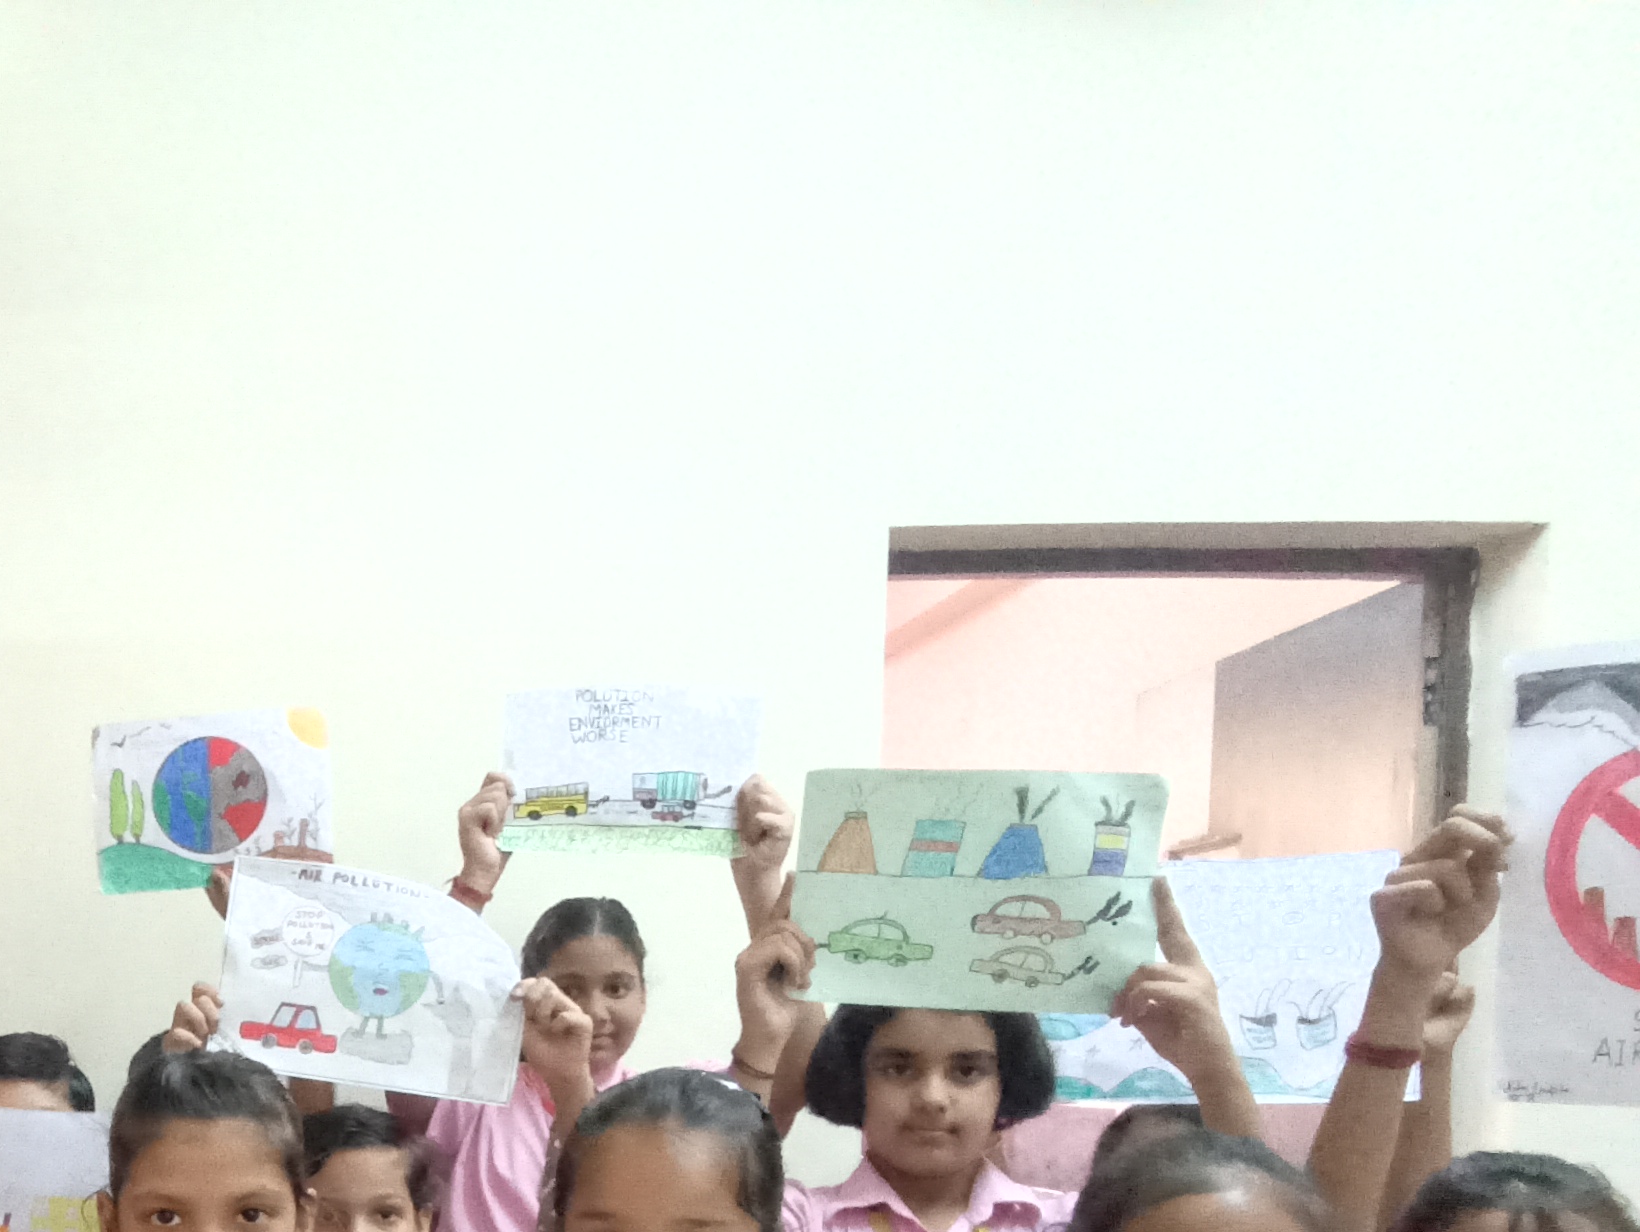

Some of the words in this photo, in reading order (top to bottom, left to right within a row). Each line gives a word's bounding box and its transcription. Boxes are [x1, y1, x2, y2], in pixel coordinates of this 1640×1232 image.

[589, 703, 635, 716] MAKES
[570, 729, 630, 744] WORSE
[331, 871, 422, 898] POLLUTION
